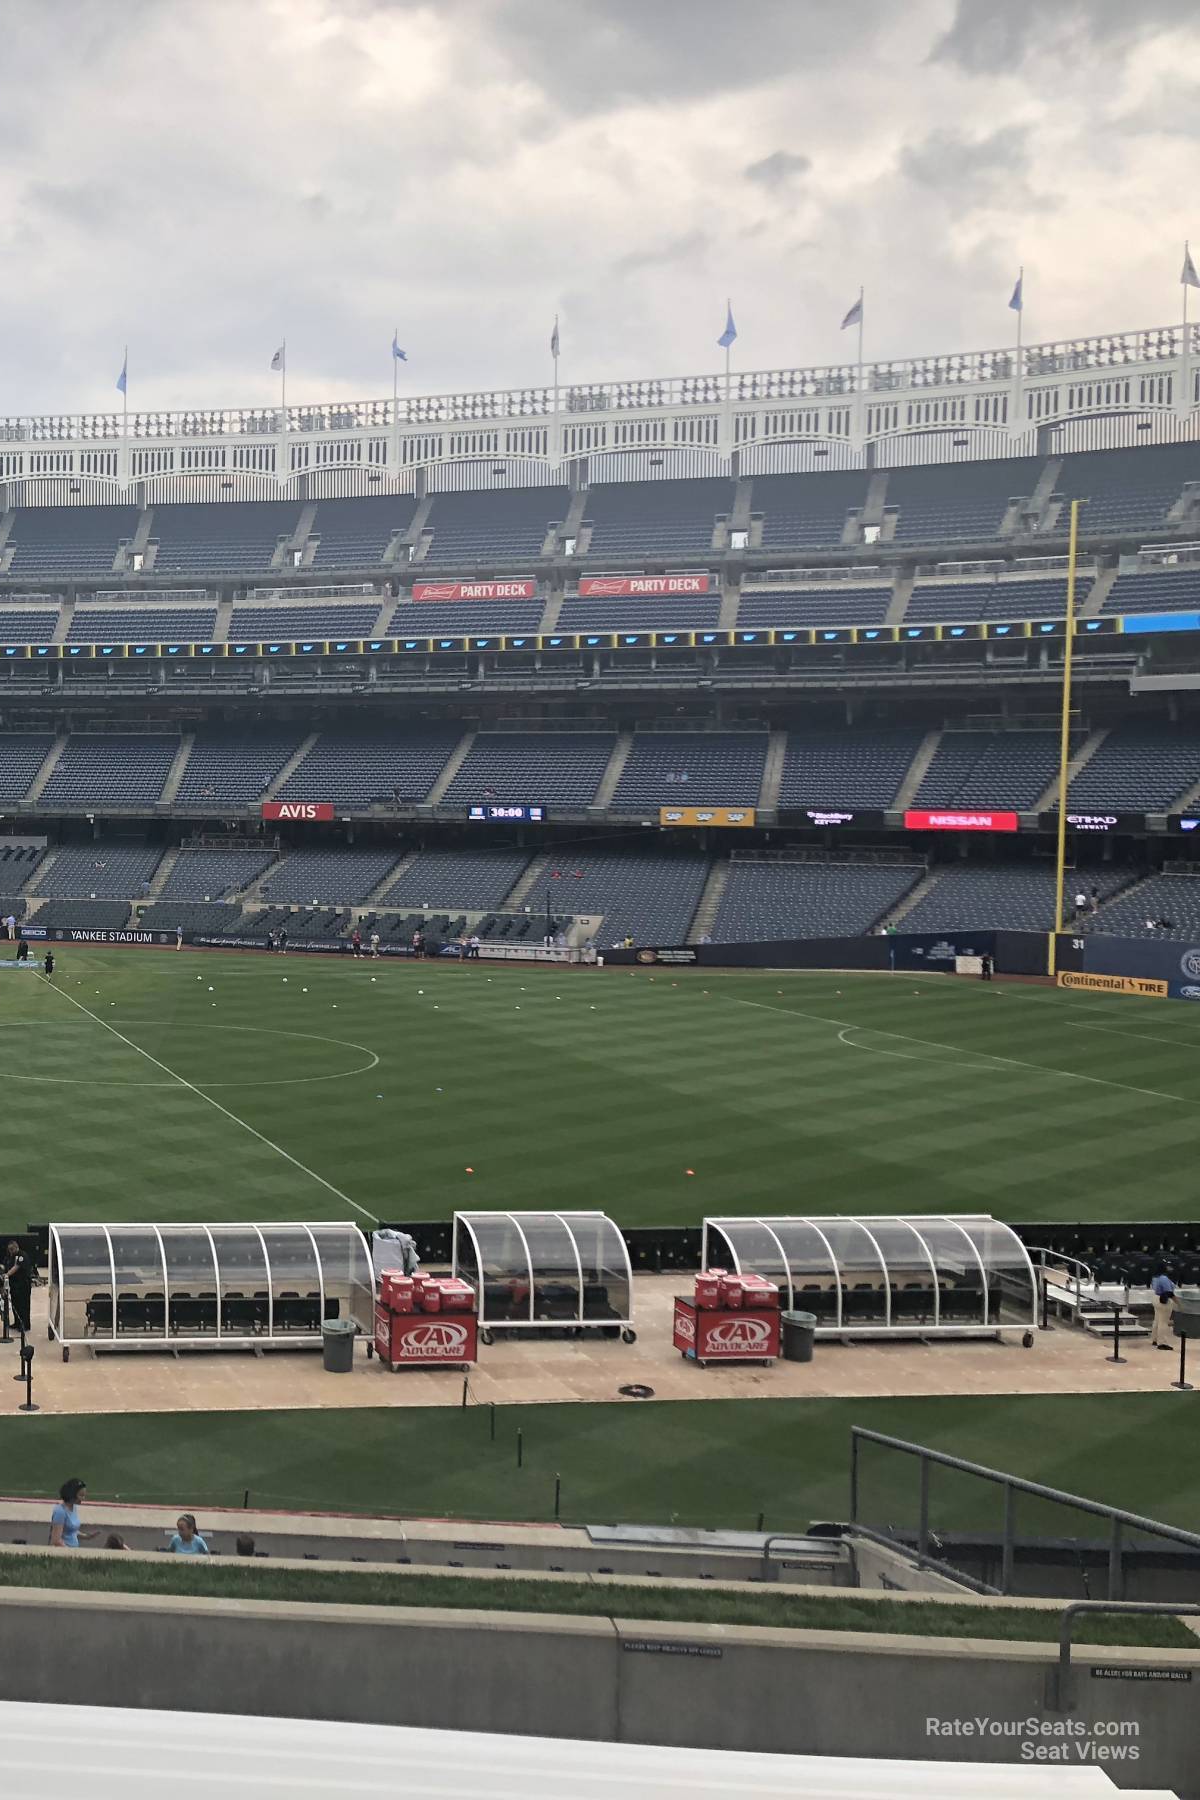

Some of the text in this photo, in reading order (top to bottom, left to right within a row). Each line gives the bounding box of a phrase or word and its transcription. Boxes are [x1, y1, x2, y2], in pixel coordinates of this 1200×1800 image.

[460, 585, 493, 597] PARTY
[497, 584, 526, 596] DECK
[630, 580, 666, 592] PARTY
[669, 579, 699, 590] DECK
[279, 804, 316, 818] AVIS
[491, 805, 522, 817] 30:00
[928, 815, 992, 826] NISSAN
[1066, 815, 1117, 824] ETIHAD
[71, 930, 152, 942] YANKEE STADIUM
[1061, 972, 1164, 993] Continental TIRE
[706, 1341, 768, 1352] ADVOCARE
